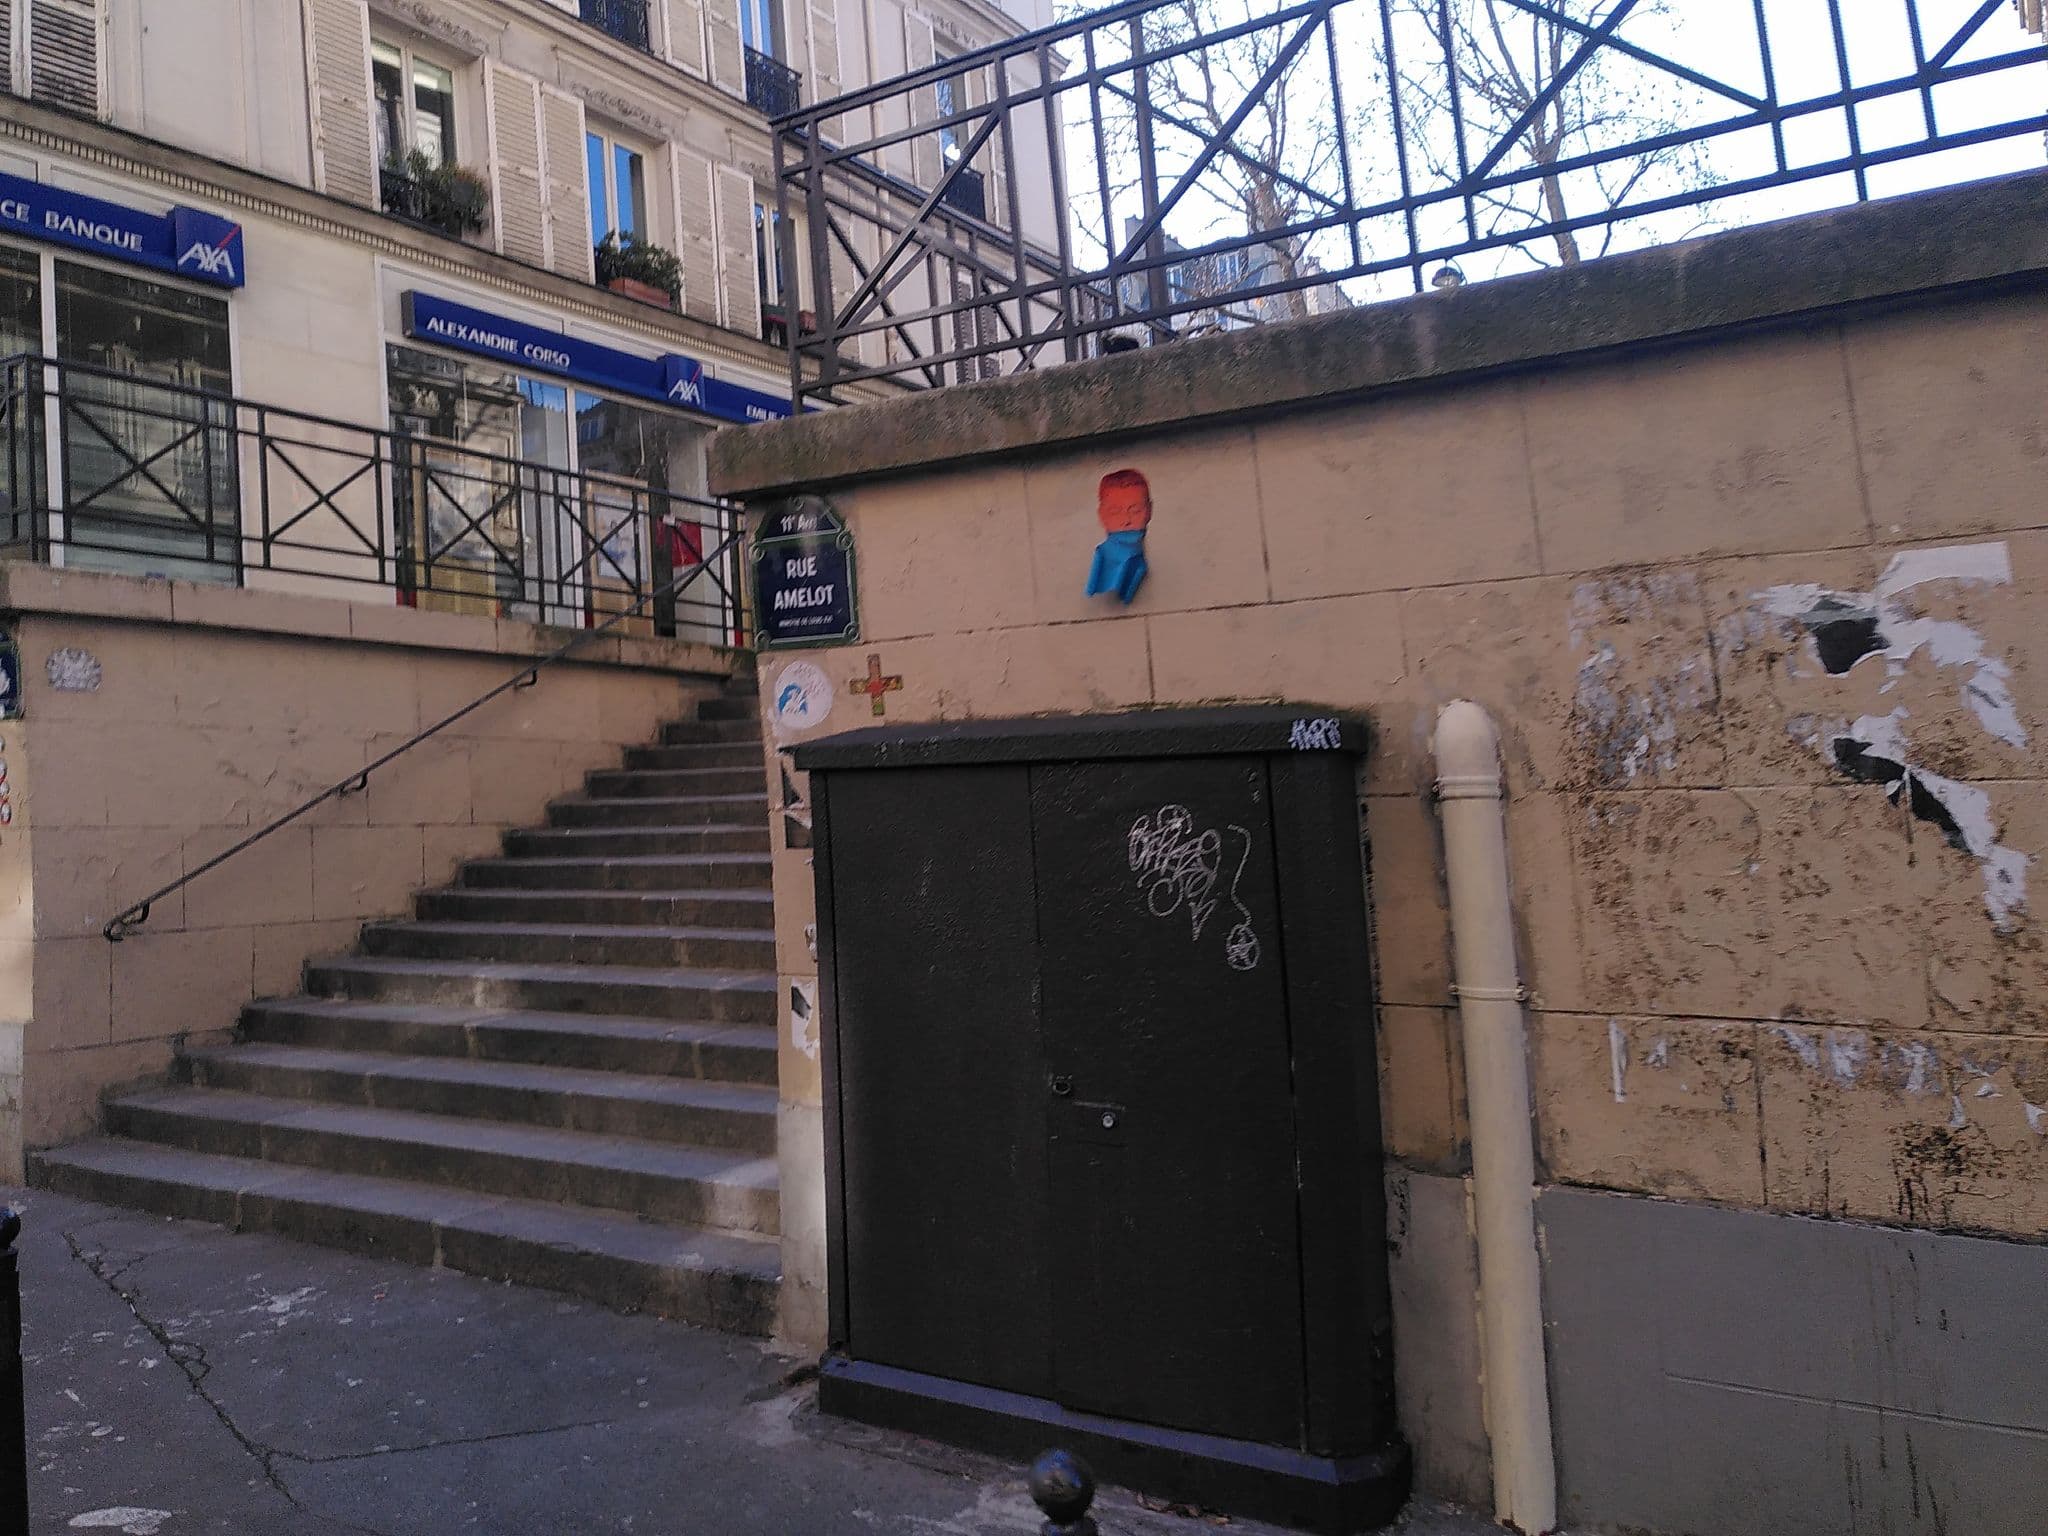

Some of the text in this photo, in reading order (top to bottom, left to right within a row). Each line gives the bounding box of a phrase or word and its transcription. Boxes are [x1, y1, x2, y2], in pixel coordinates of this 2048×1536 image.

[44, 209, 143, 253] BANQUE
[177, 242, 235, 279] AXA
[427, 315, 571, 369] ALEXANDRE CORSO
[667, 378, 701, 406] AXA
[786, 556, 818, 579] RUE
[773, 584, 835, 610] AMELOT
